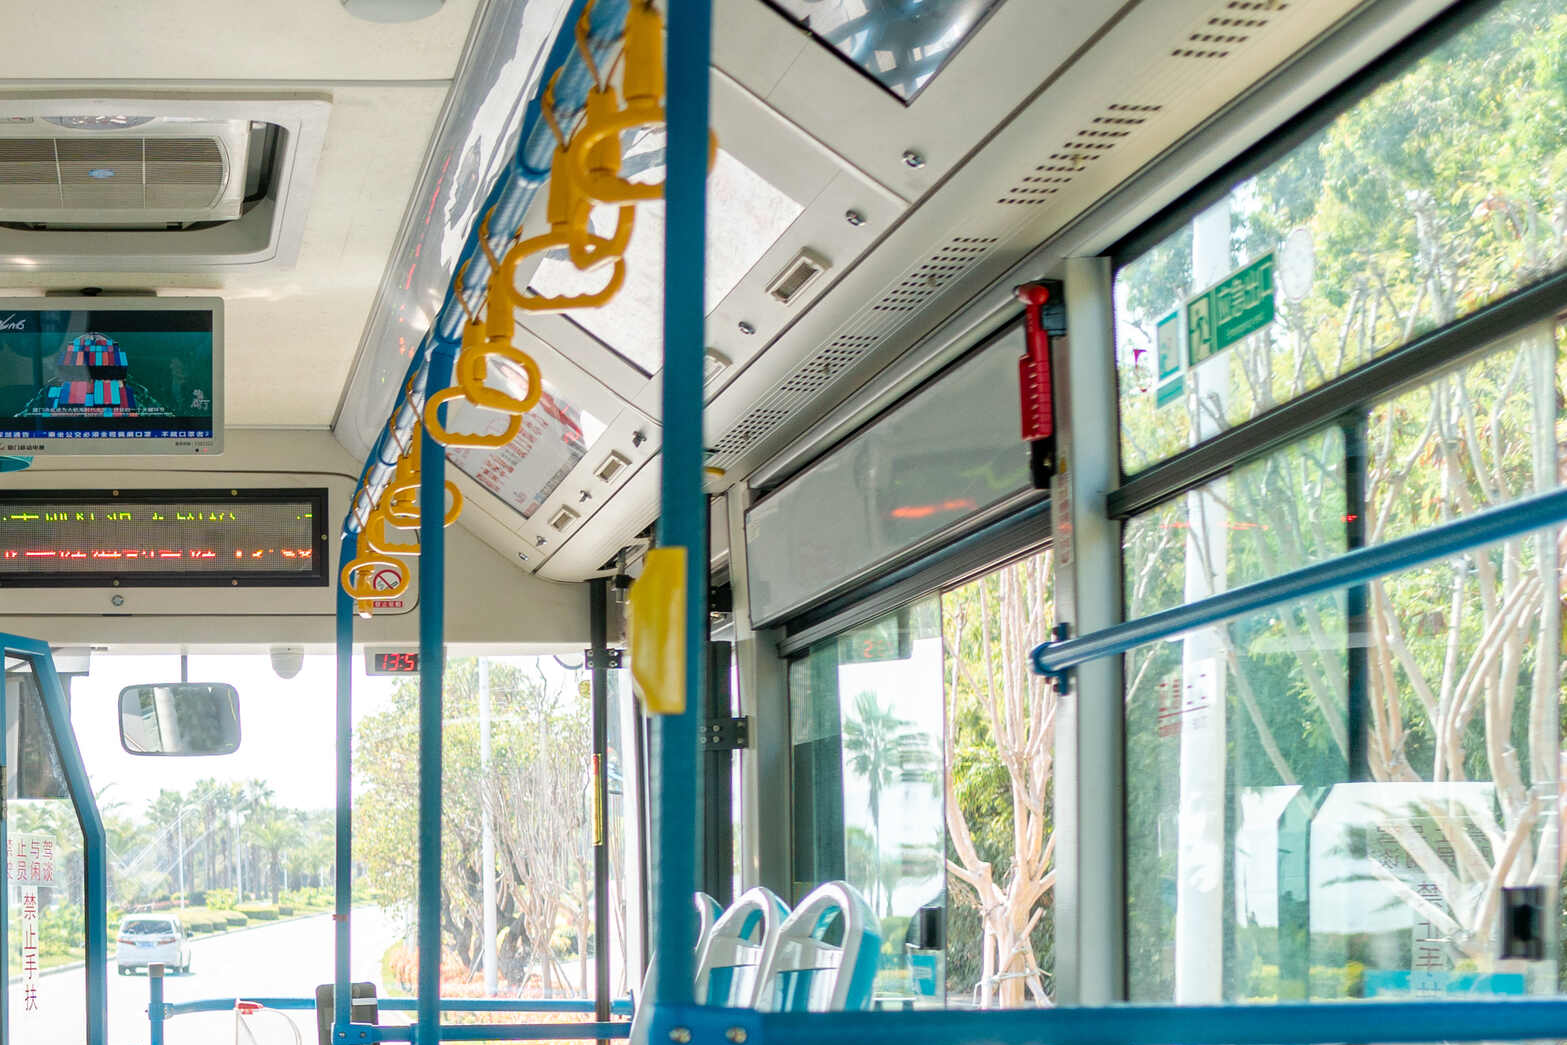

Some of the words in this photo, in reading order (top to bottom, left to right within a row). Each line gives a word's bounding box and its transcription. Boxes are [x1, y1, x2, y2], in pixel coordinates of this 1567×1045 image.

[382, 653, 416, 671] 13:5
[23, 895, 38, 1011] 禁止手扶
